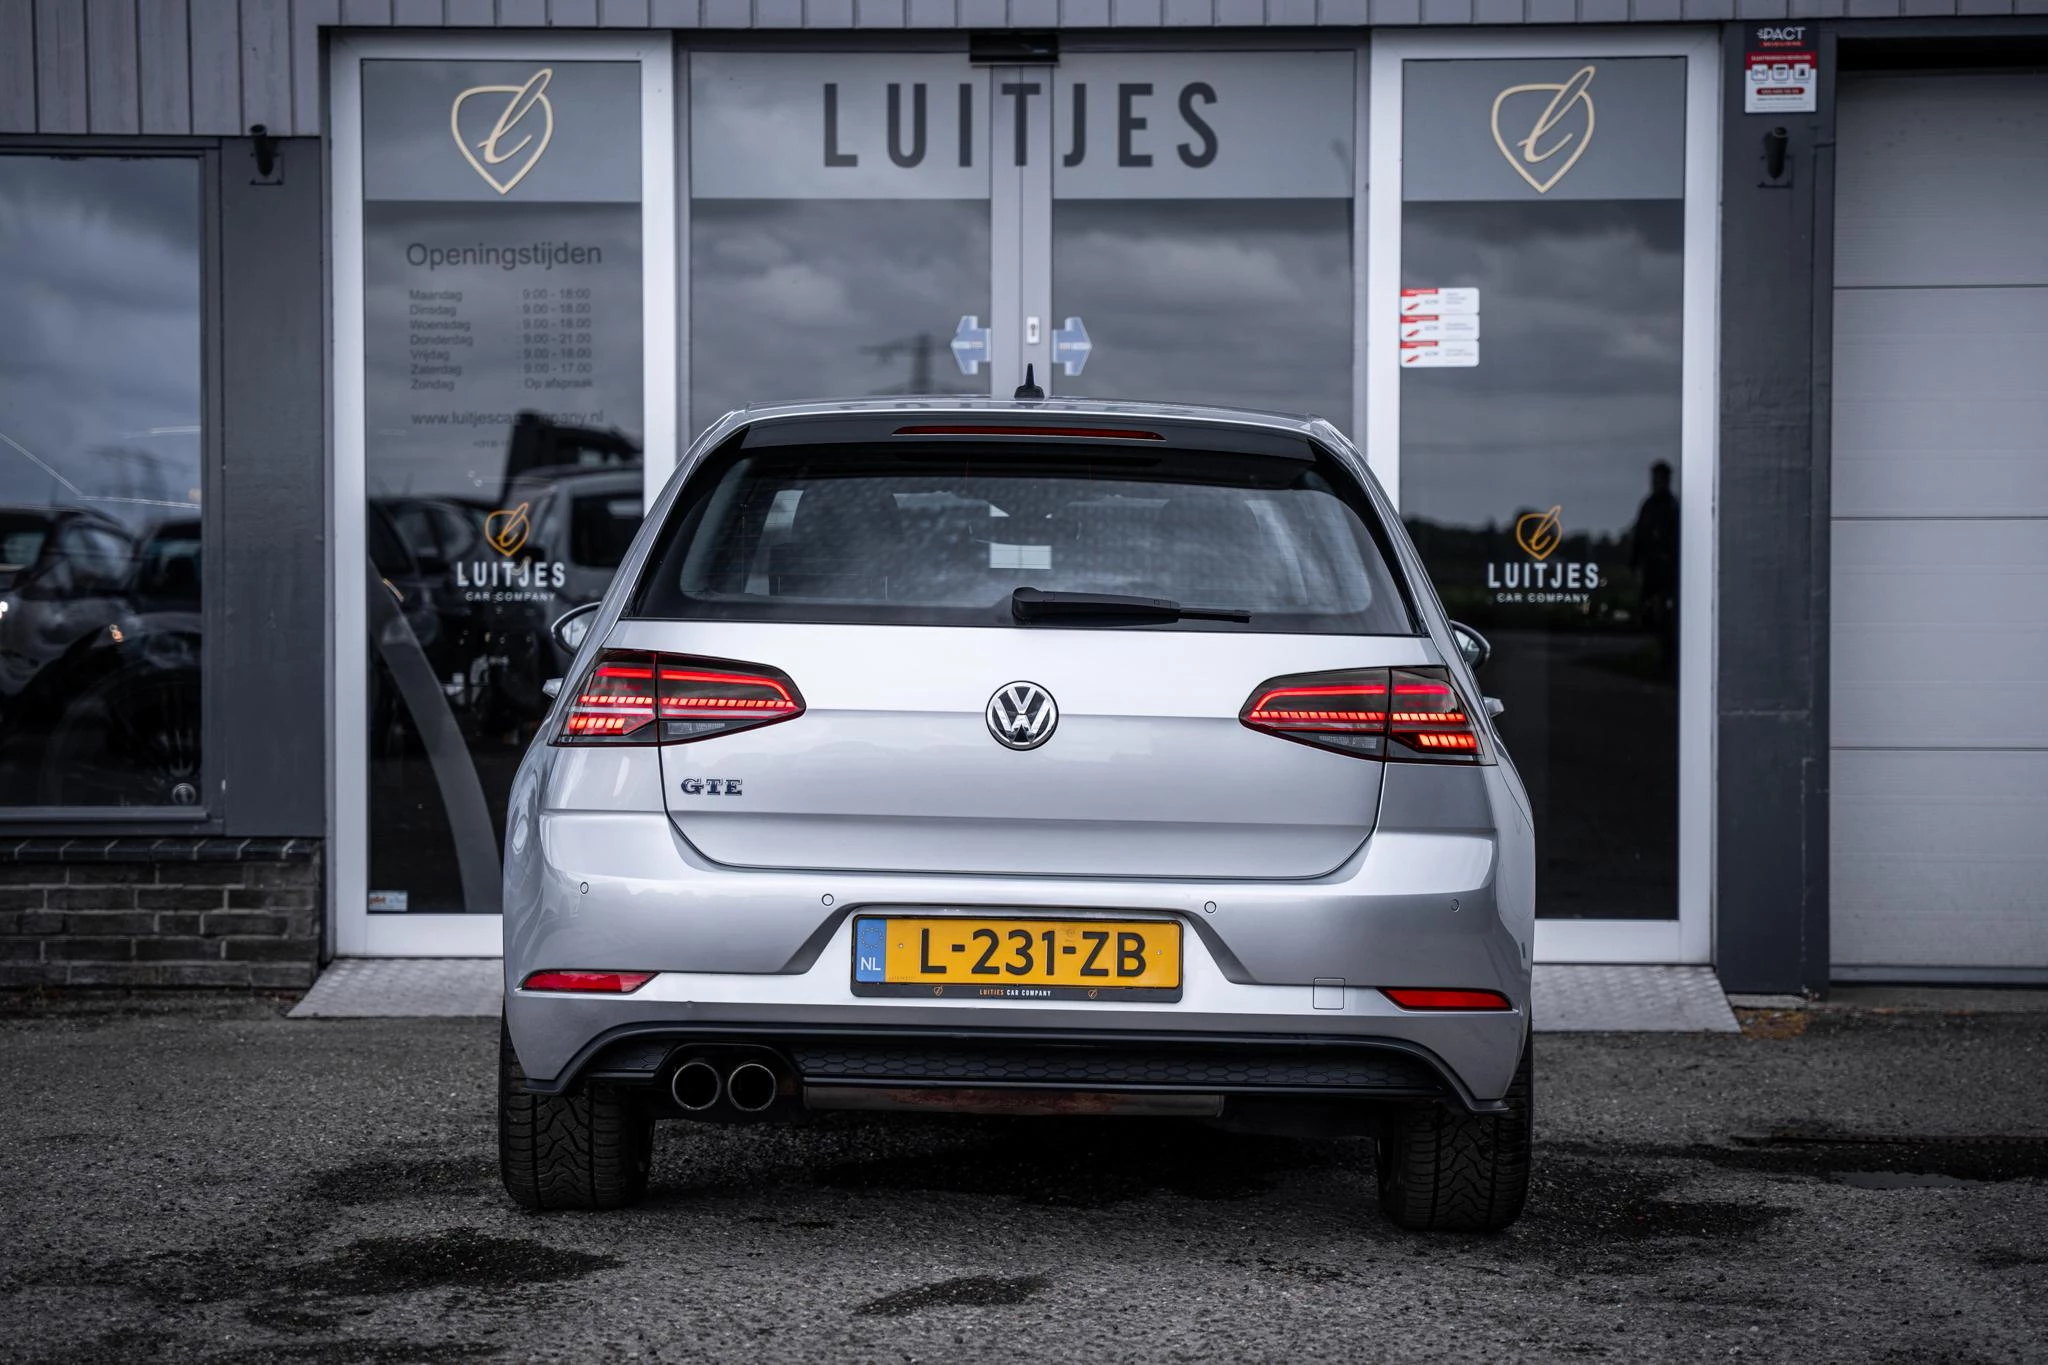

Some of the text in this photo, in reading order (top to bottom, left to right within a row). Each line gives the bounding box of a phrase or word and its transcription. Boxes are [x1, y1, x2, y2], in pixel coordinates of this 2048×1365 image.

[823, 82, 1219, 169] LUITJES
[406, 242, 602, 271] Openingstijden
[409, 289, 463, 303] Maandag
[409, 304, 457, 317] Dinsdag
[409, 319, 471, 332] Woensdag
[410, 334, 474, 347] Donderdag
[410, 349, 450, 363] Vrijdag
[410, 363, 462, 376] Zaterdag
[410, 378, 455, 392] Zondag
[457, 561, 565, 588] LUITJES
[1487, 562, 1599, 589] LUITJES
[465, 592, 555, 601] CAR COMPANY
[1496, 592, 1589, 602] CAR COMPANY
[681, 778, 742, 796] GTE
[920, 928, 1147, 977] L-231-ZB
[860, 957, 882, 972] NL
[1021, 989, 1051, 997] COMPANY
